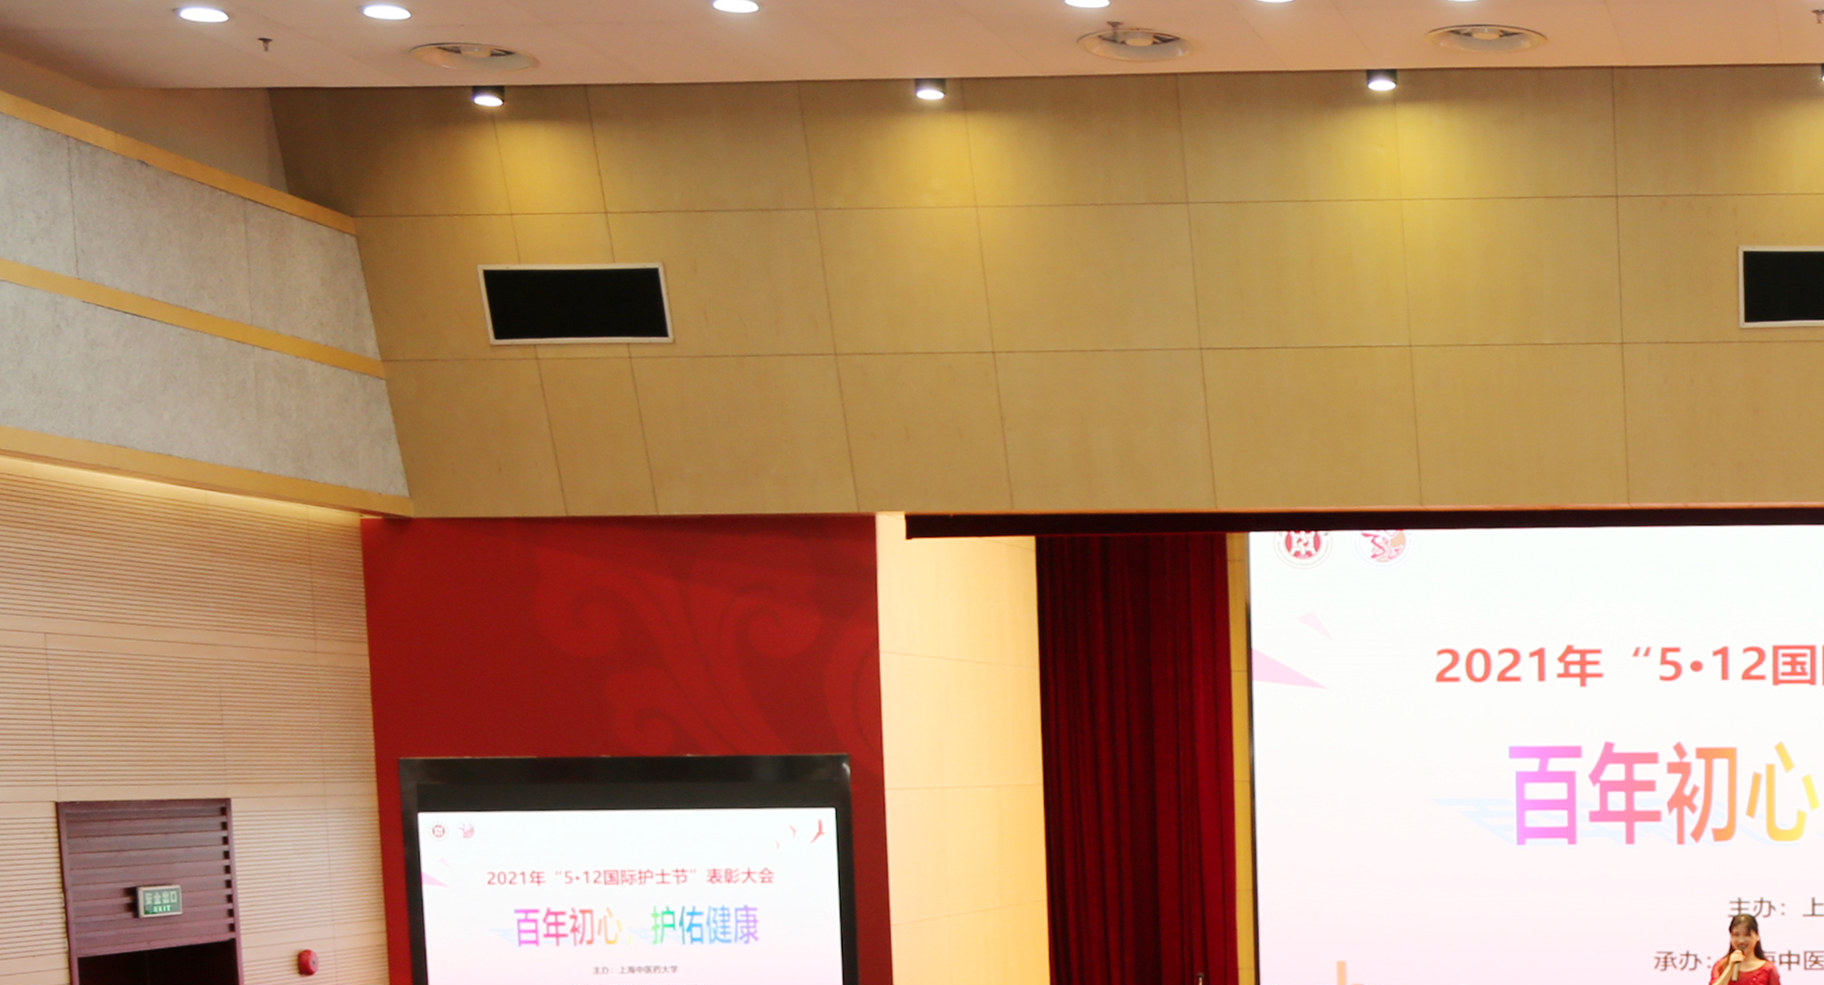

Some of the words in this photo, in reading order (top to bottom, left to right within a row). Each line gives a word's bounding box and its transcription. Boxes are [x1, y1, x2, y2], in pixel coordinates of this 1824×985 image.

[513, 905, 760, 947] 百年初心，护佑健康
